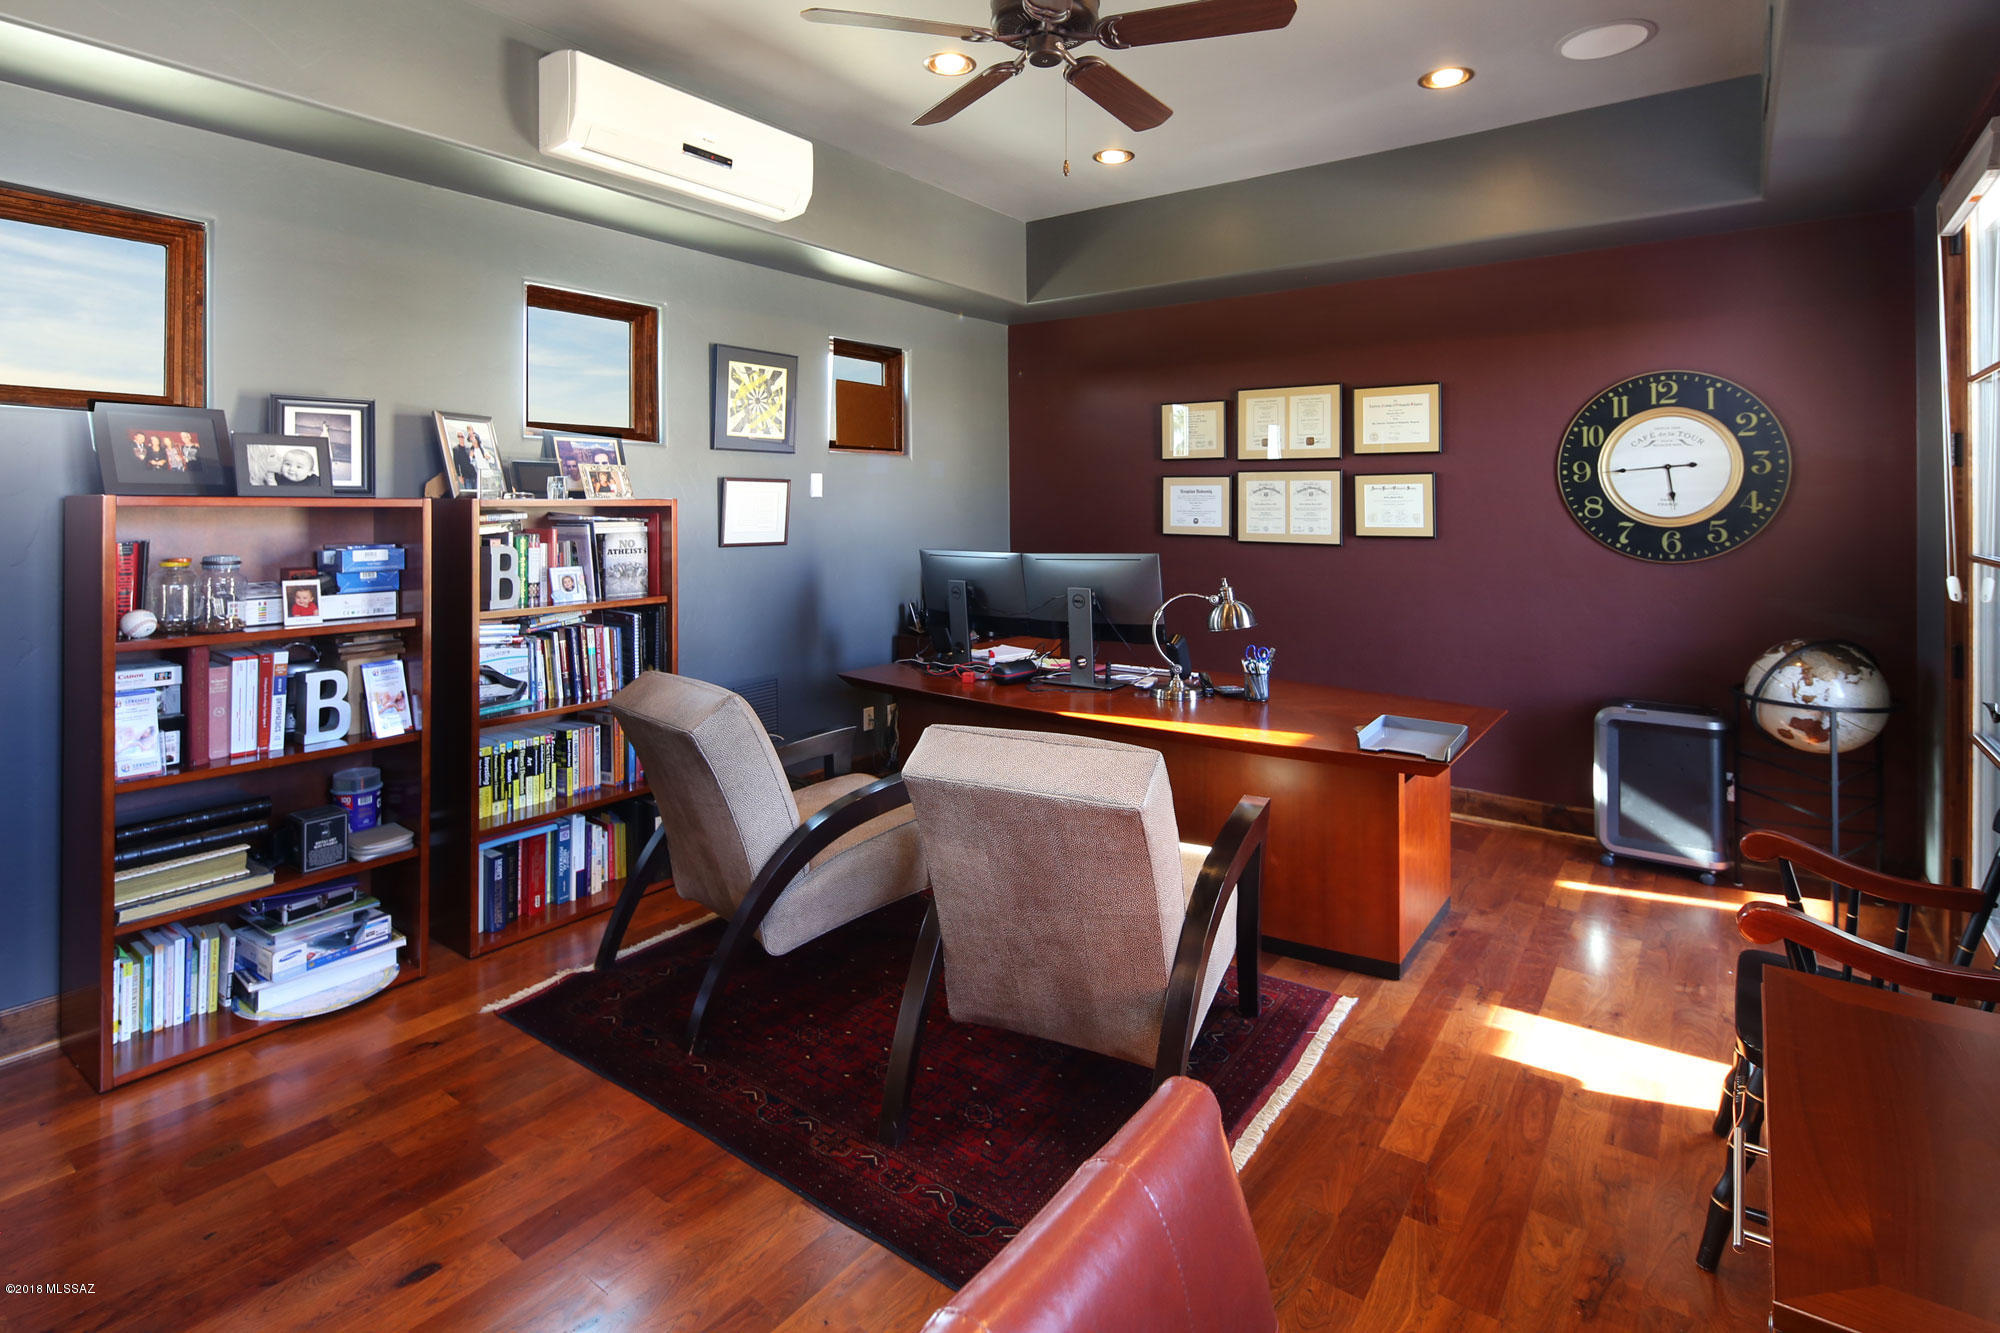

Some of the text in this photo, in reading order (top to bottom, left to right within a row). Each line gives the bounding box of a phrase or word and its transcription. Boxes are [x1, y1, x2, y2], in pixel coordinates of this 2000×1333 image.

[1650, 380, 1678, 405] 12
[1706, 386, 1715, 410] 1
[1611, 395, 1629, 418] 11
[1735, 412, 1758, 436] 2
[1581, 425, 1604, 448] 10
[1572, 460, 1591, 483] 9
[1751, 450, 1772, 475] 3
[1584, 496, 1604, 518] 8
[1740, 490, 1763, 513] 4
[1618, 521, 1635, 544] 7
[1661, 530, 1682, 554] 6
[1707, 519, 1728, 543] 5
[618, 539, 635, 548] NO
[490, 544, 521, 610] B
[304, 669, 350, 745] B
[483, 756, 491, 785] Investing
